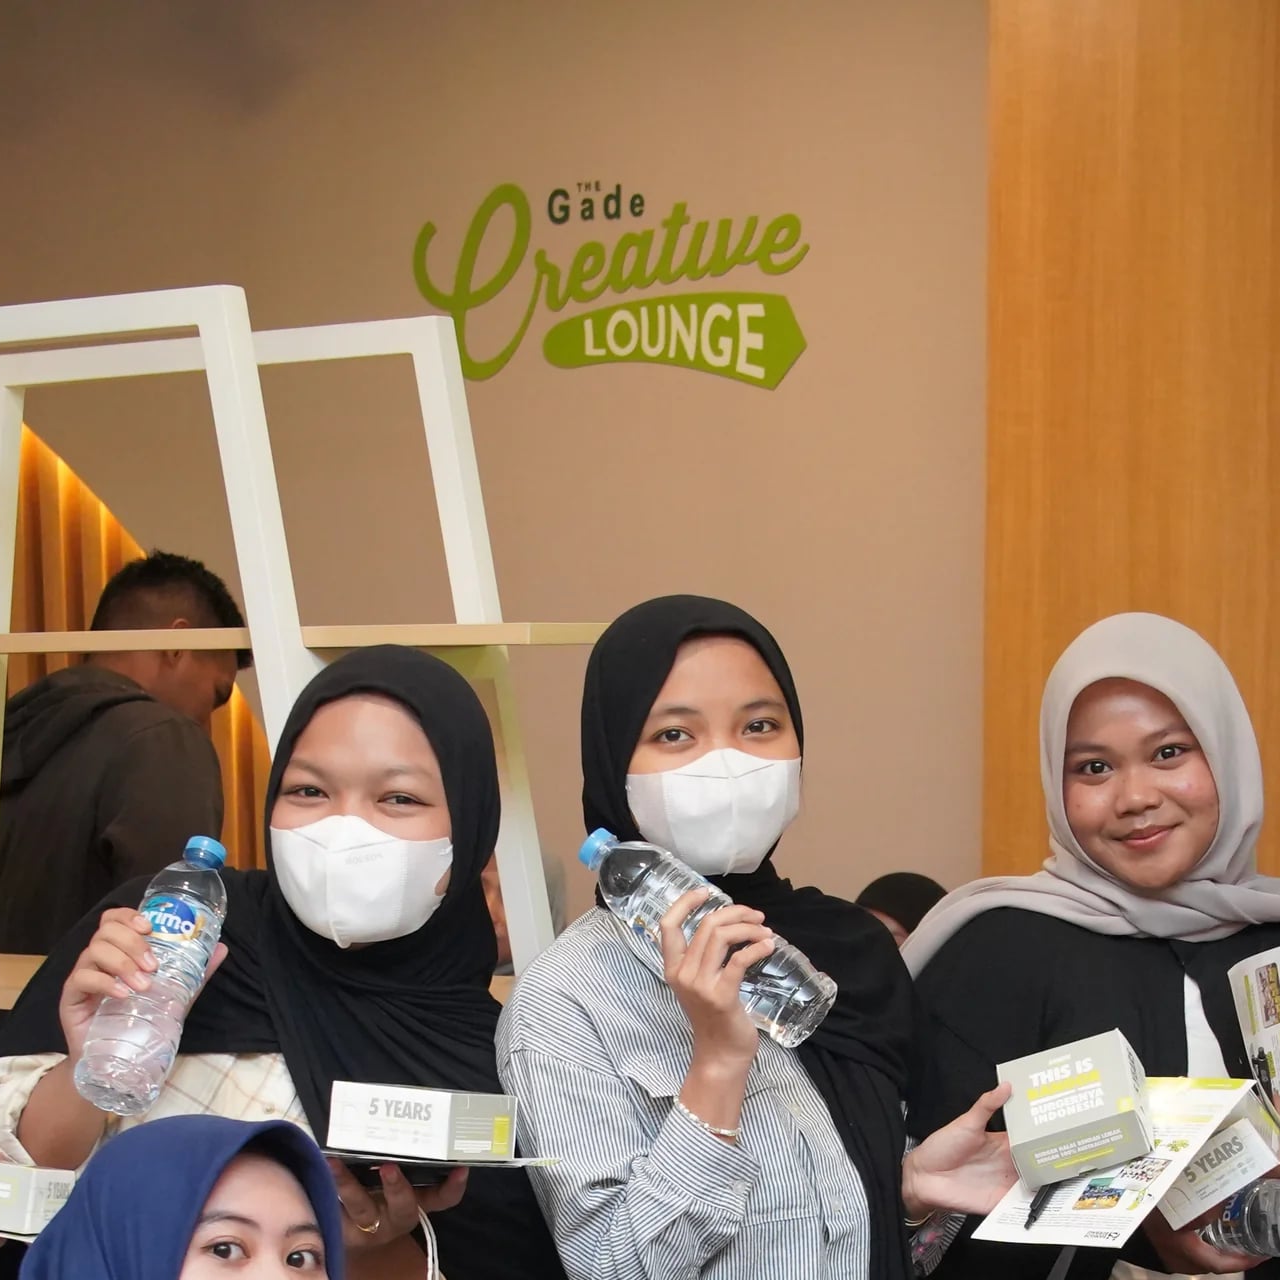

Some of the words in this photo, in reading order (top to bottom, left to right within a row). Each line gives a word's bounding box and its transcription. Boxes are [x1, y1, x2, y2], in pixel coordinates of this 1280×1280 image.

[577, 181, 601, 192] THE
[548, 184, 645, 224] Gade
[413, 183, 810, 381] Creative
[584, 303, 766, 379] LOUNGE
[1029, 1063, 1071, 1087] THIS
[1075, 1058, 1094, 1074] IS
[369, 1098, 378, 1116] 5
[384, 1099, 433, 1122] YEARS
[1034, 1098, 1105, 1126] INDONESIA
[1183, 1166, 1197, 1183] 5
[1194, 1136, 1244, 1173] YEARS
